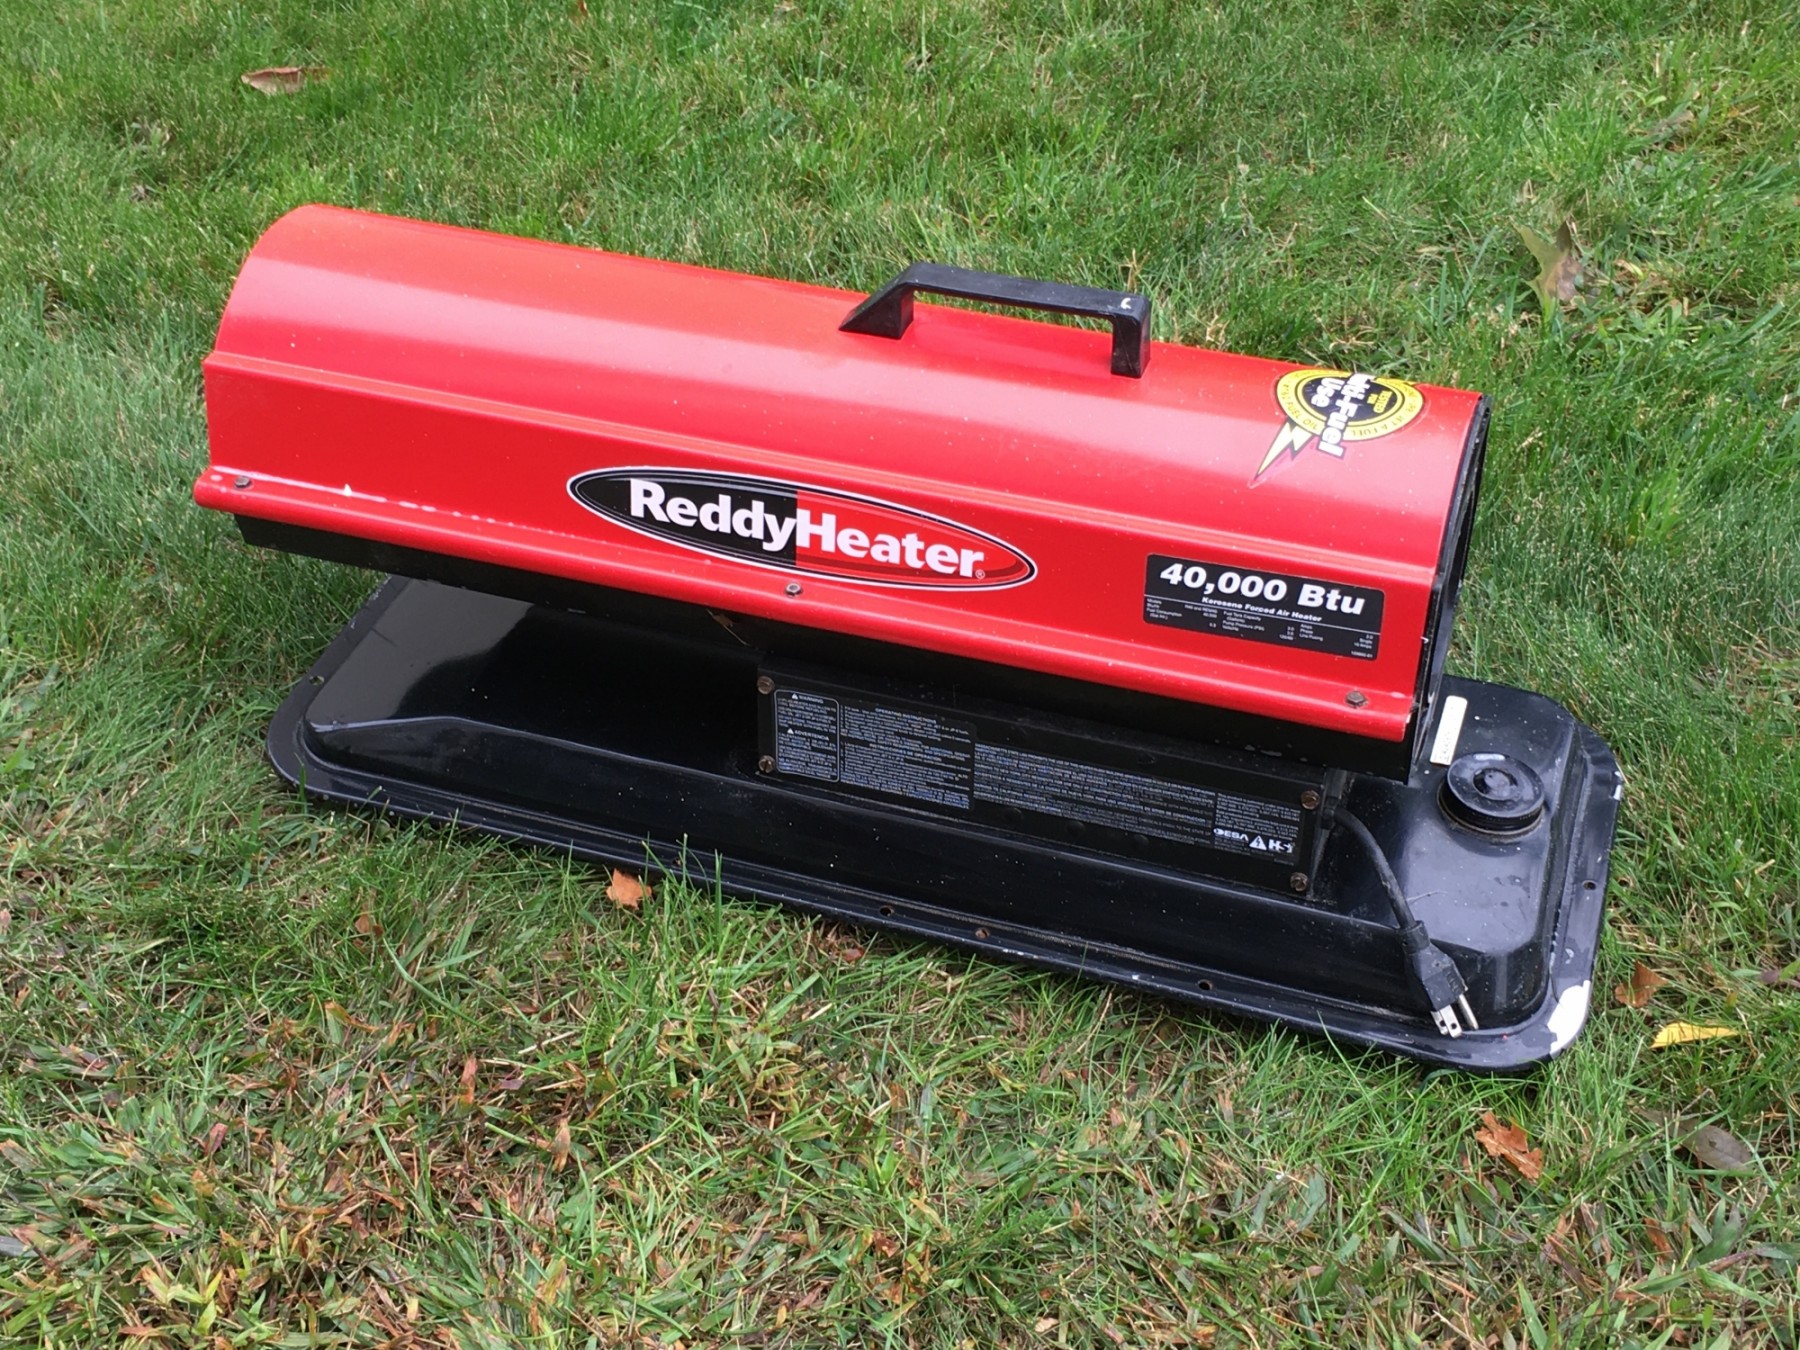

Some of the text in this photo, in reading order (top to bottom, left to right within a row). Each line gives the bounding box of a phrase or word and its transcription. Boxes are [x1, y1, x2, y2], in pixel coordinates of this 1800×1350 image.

[1311, 377, 1345, 408] Use
[630, 478, 985, 578] ReddyHeater
[1160, 562, 1365, 616] 40,000 Btu
[1202, 596, 1322, 621] Kerosene Forced Air Heater
